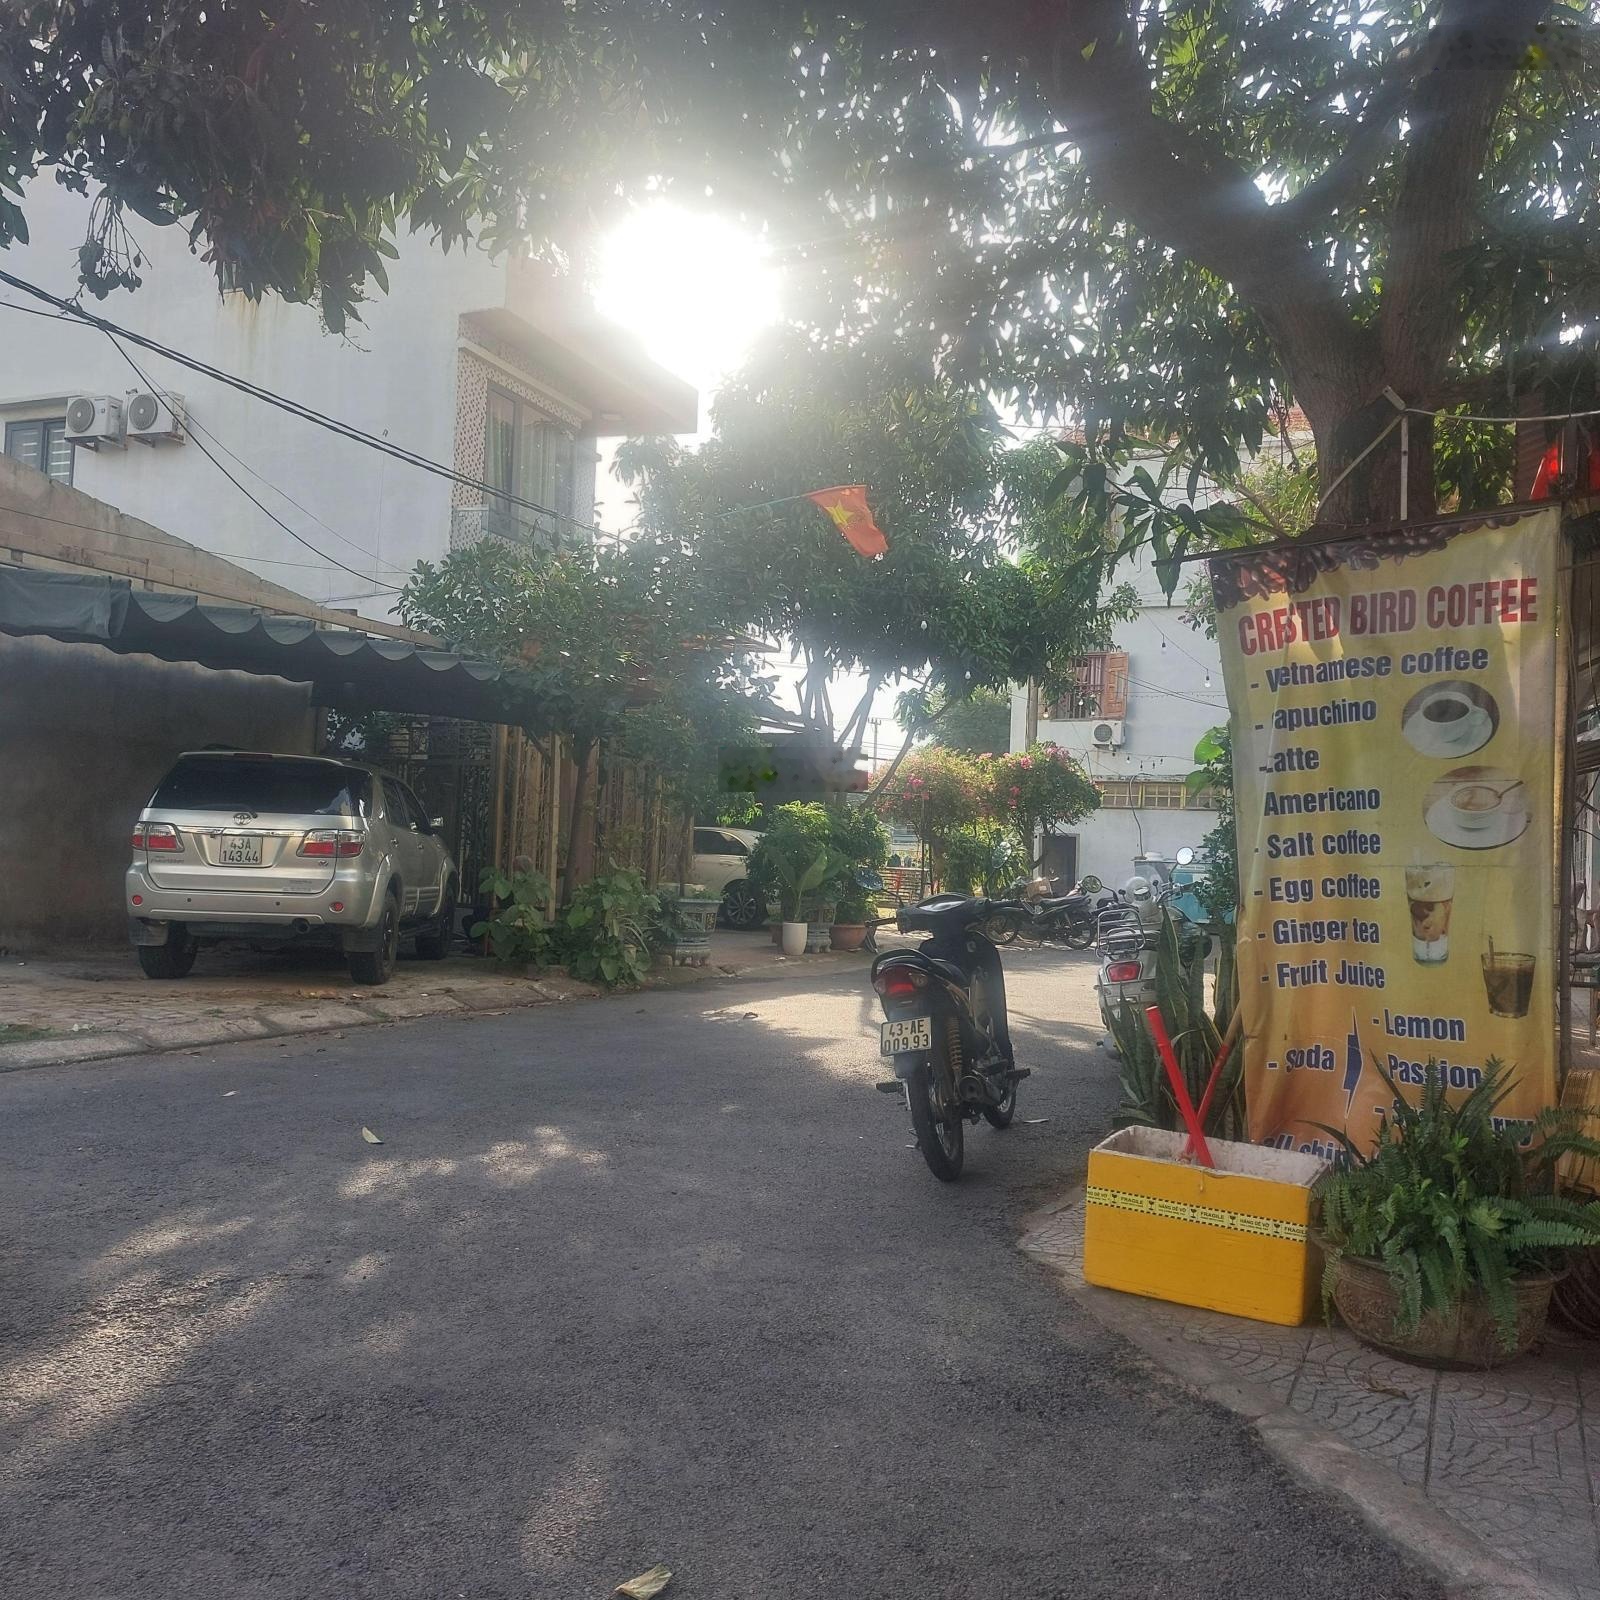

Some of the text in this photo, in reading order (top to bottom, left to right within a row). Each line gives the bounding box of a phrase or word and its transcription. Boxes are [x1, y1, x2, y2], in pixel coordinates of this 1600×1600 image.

[1349, 589, 1417, 636] BIRD
[1426, 578, 1538, 630] COFFEE
[1401, 647, 1489, 675] coffee
[1272, 699, 1377, 731] apuchino
[1264, 787, 1381, 816] Americano
[222, 850, 259, 864] 143.44
[229, 836, 252, 850] 43A
[1267, 829, 1381, 859] Salt coffee
[1269, 873, 1381, 904] Egg coffee
[1273, 918, 1380, 946] Ginger tea
[1277, 959, 1386, 989] Fruit Juice
[889, 1019, 925, 1037] 43-AE
[1384, 1008, 1465, 1042] Lemon
[884, 1033, 929, 1051] 009.93
[1285, 1044, 1335, 1073] soda
[1387, 1054, 1482, 1089] Pasion
[1200, 1211, 1225, 1220] FRAGILE
[1284, 1226, 1308, 1236] FRAGIL
